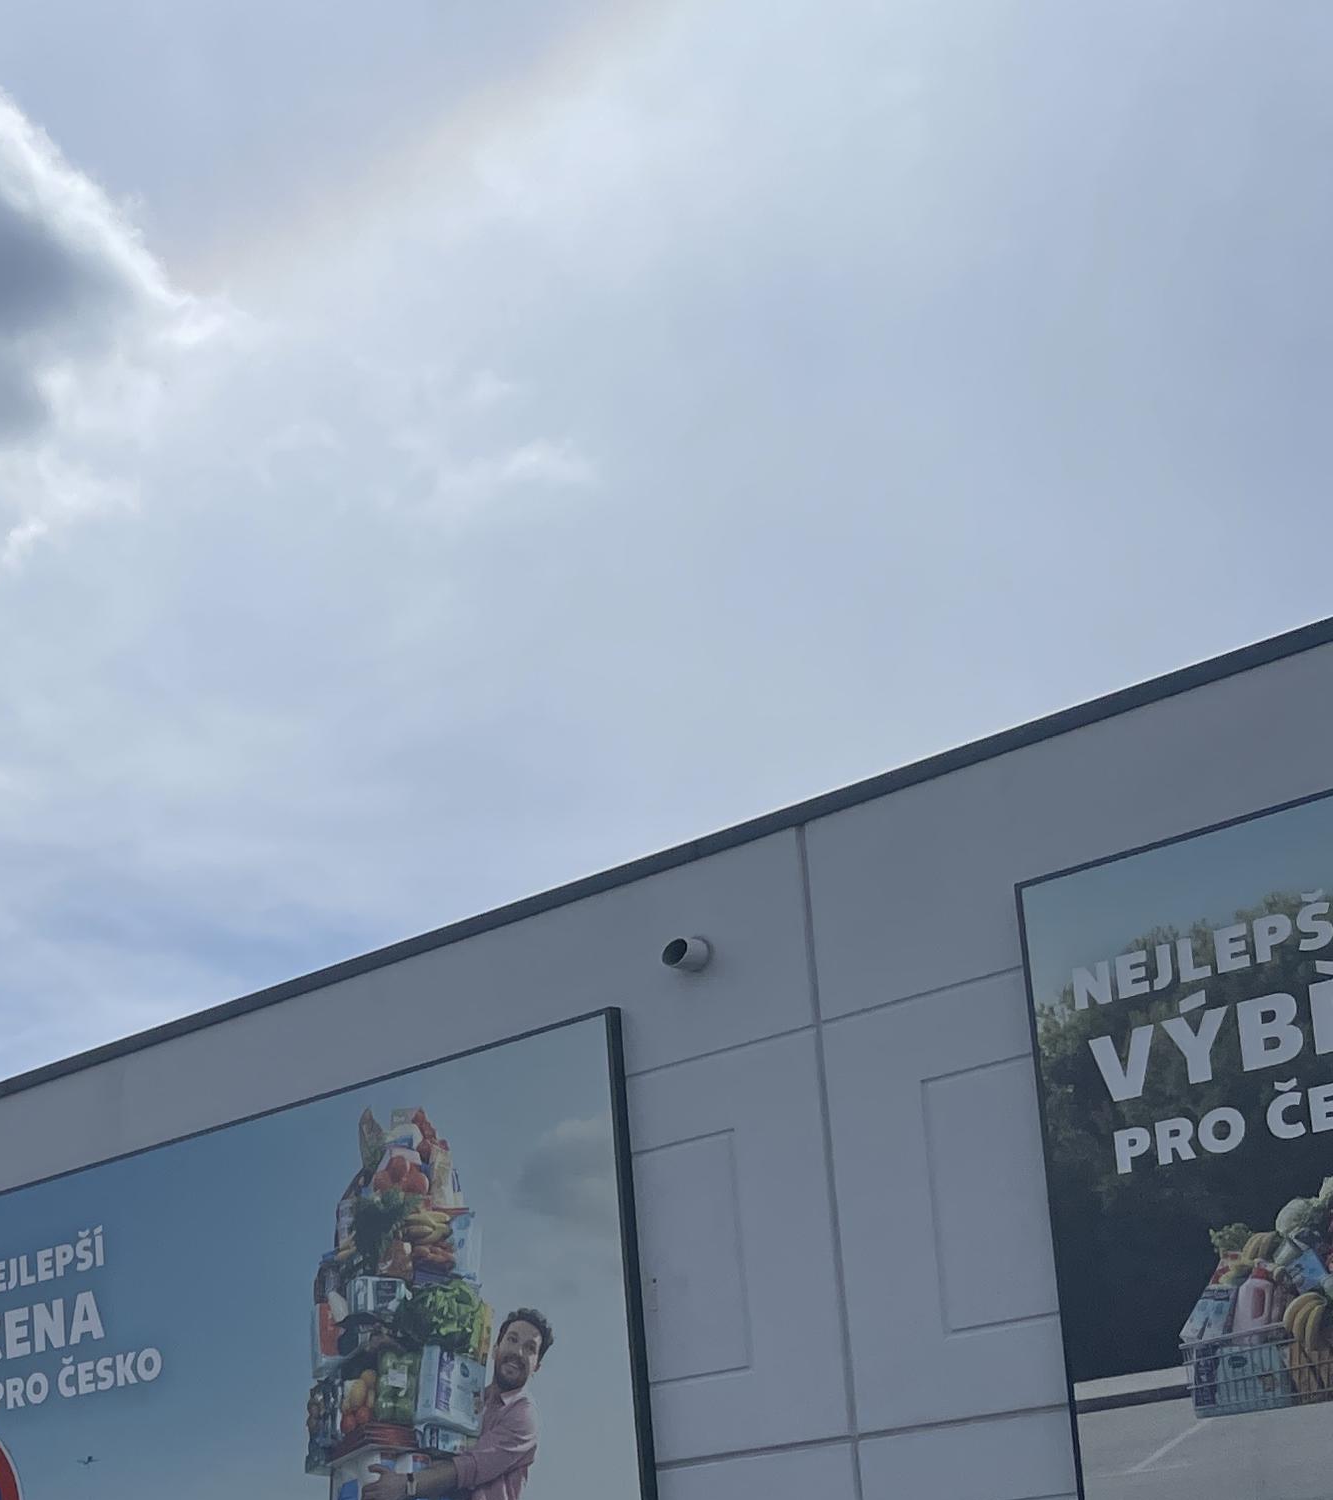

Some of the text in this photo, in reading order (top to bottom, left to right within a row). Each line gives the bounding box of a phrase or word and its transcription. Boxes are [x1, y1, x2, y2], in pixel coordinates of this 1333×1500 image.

[1072, 888, 1333, 1010] NEJLEPŠ
[1113, 1106, 1246, 1175] PRO
[57, 1348, 162, 1398] ČESKO
